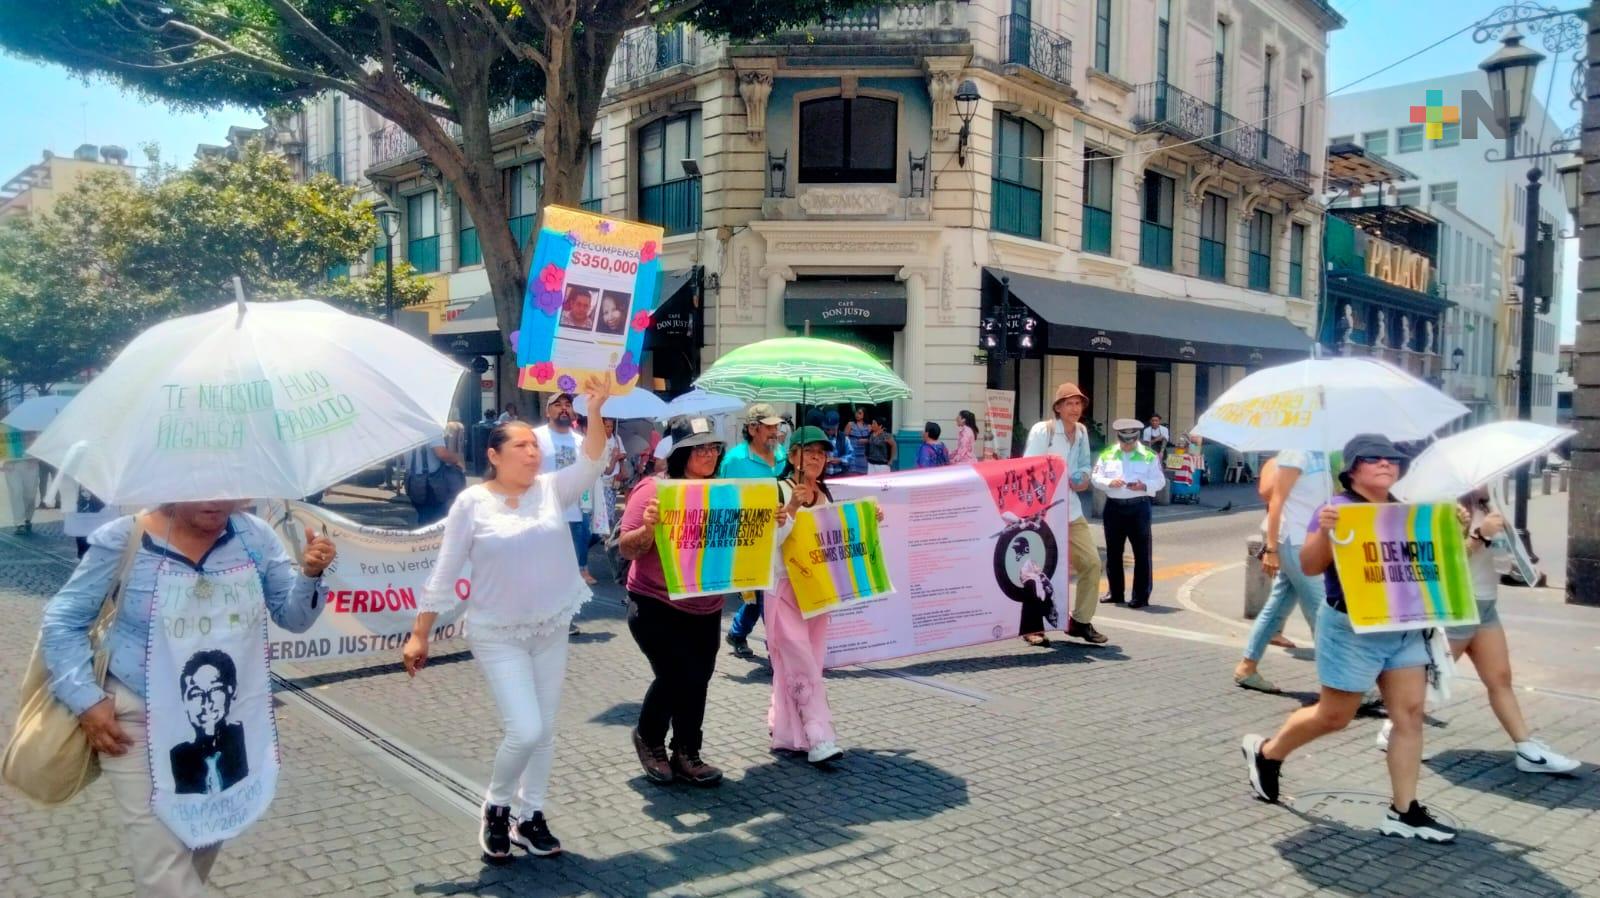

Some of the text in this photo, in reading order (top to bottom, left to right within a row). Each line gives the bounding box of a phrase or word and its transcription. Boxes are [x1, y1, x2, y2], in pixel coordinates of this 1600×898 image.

[571, 251, 638, 275] $350,000
[822, 307, 871, 319] DON JUSTO
[656, 319, 693, 330] DON JUST
[163, 369, 330, 413] TE NECESITO HIJO
[273, 393, 356, 441] PRONTO
[662, 510, 681, 526] 2011
[709, 508, 724, 525] QUE
[724, 508, 773, 525] COMENZAMOS
[669, 523, 765, 541] A CAMINAR POR NUESTRXS
[826, 530, 832, 545] A
[676, 538, 755, 550] DESAPARECIDXS
[838, 542, 867, 561] BUSCANDO
[1363, 541, 1436, 563] 10 DE MAYO
[360, 562, 379, 575] Por
[382, 561, 396, 574] la
[1363, 563, 1441, 584] NADA QUE CELEBRAR
[270, 637, 331, 660] ERDAD
